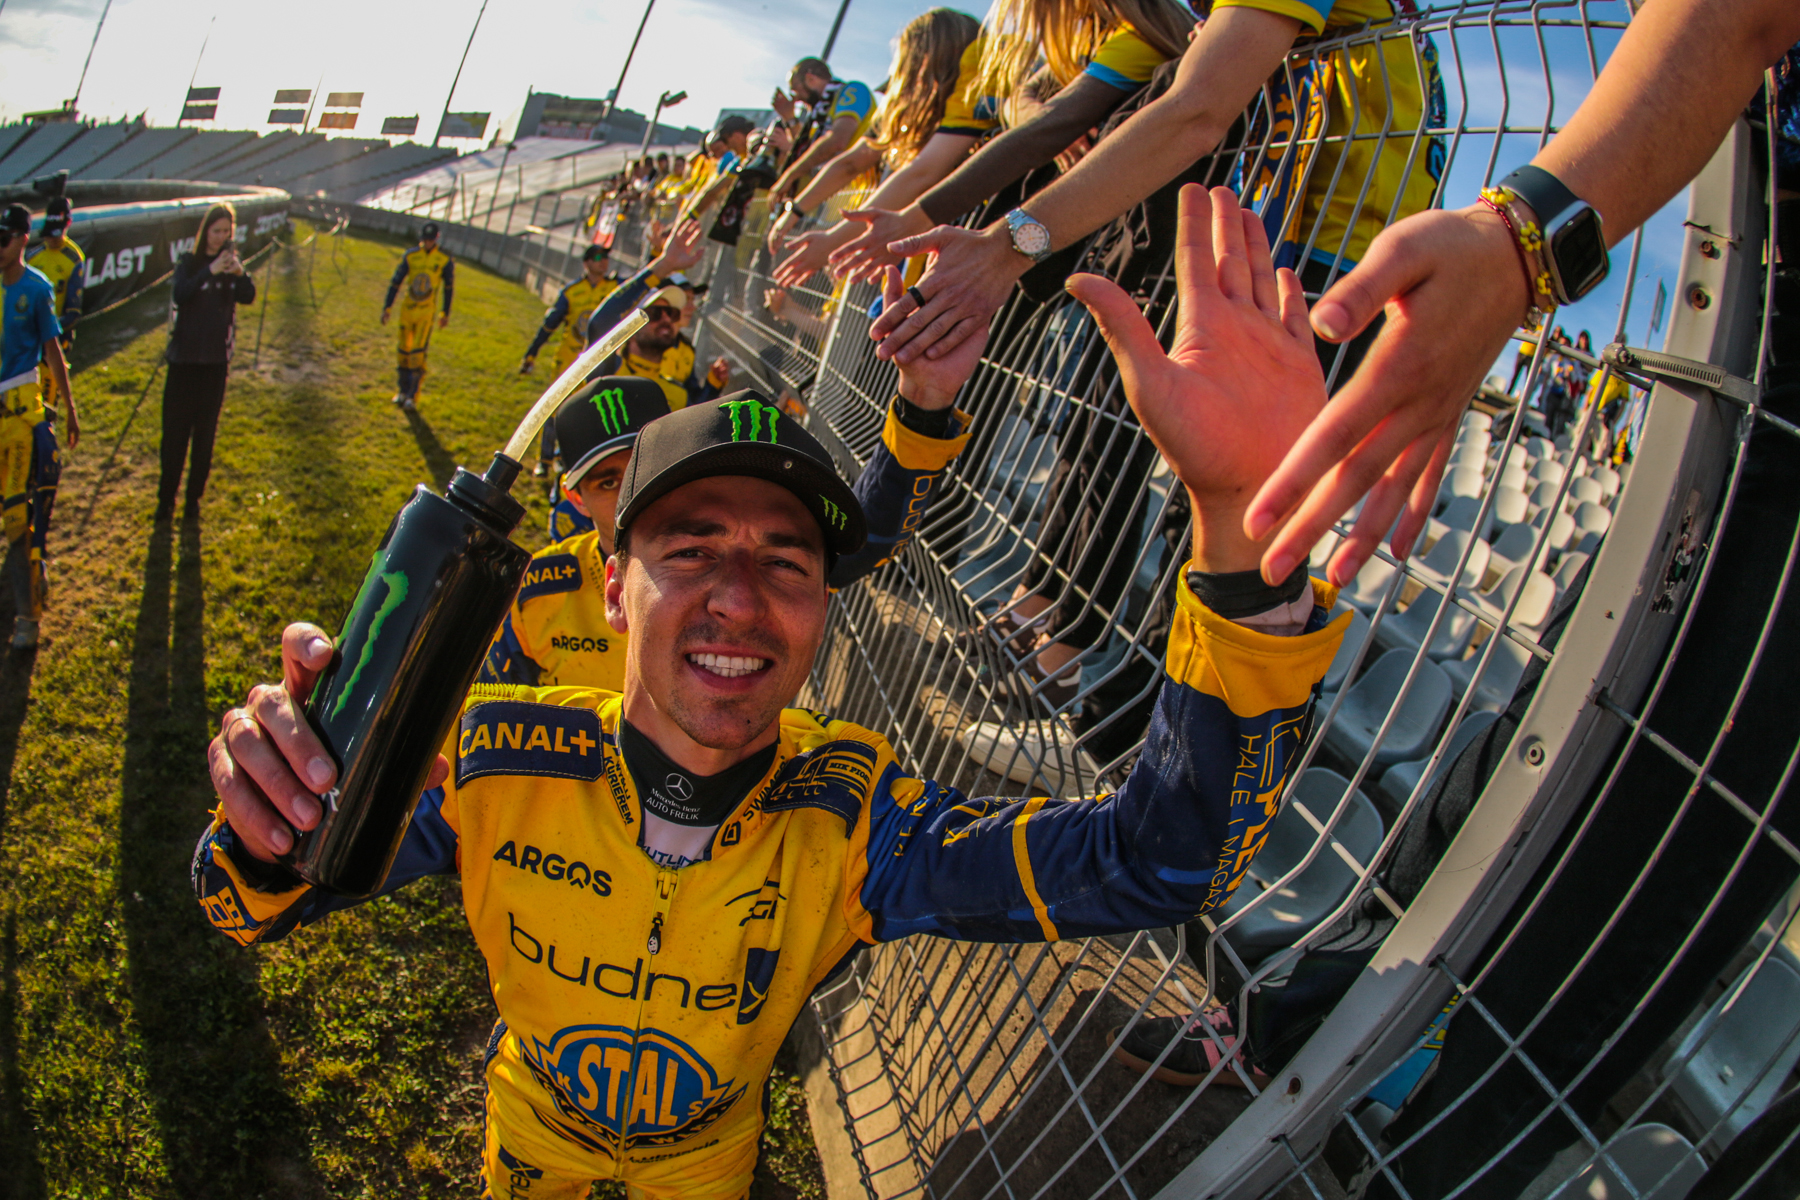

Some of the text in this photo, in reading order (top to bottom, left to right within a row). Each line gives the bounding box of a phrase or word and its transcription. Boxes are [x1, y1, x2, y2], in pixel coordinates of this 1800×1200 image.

[874, 473, 941, 568] budne
[551, 635, 609, 653] ARGOS
[458, 721, 596, 760] CANAL+
[1230, 734, 1262, 807] HALE
[604, 756, 634, 825] KURIEREM
[646, 796, 699, 821] AUTO FRELIK
[493, 840, 612, 897] ARGOS
[578, 1043, 679, 1127] STAL
